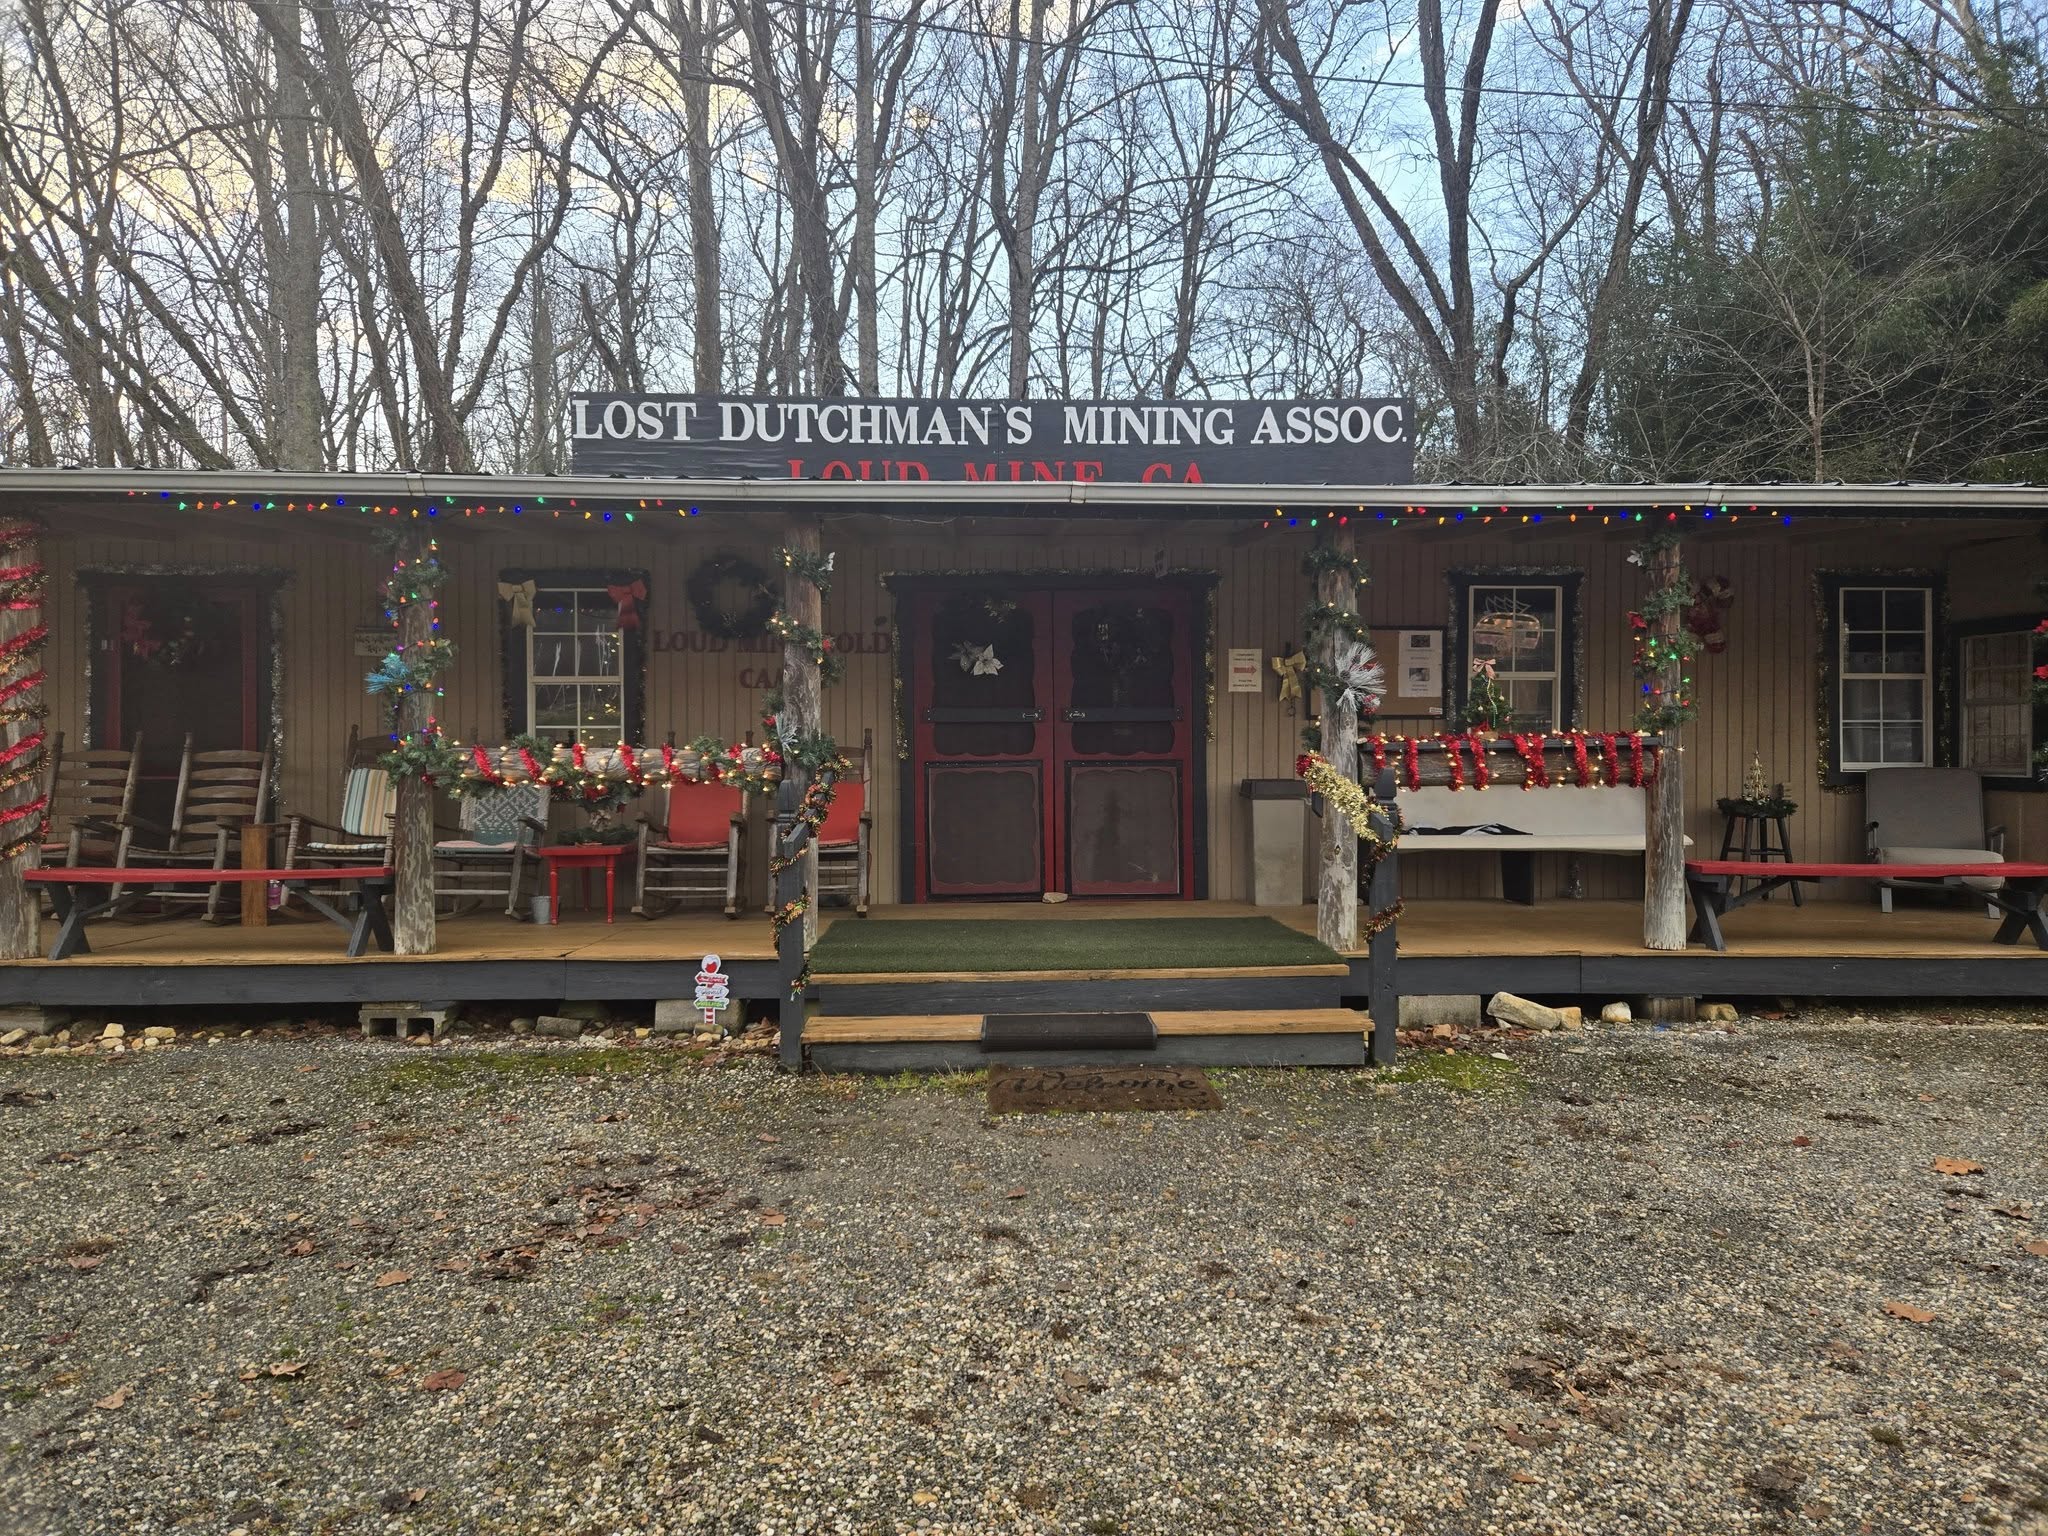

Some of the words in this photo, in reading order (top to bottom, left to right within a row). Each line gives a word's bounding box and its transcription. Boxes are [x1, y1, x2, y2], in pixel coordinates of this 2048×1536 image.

[572, 399, 697, 441] LOST
[1063, 405, 1234, 446] MINING
[1250, 404, 1408, 444] ASSOC.
[653, 629, 729, 653] LOUD
[828, 631, 891, 654] OLD
